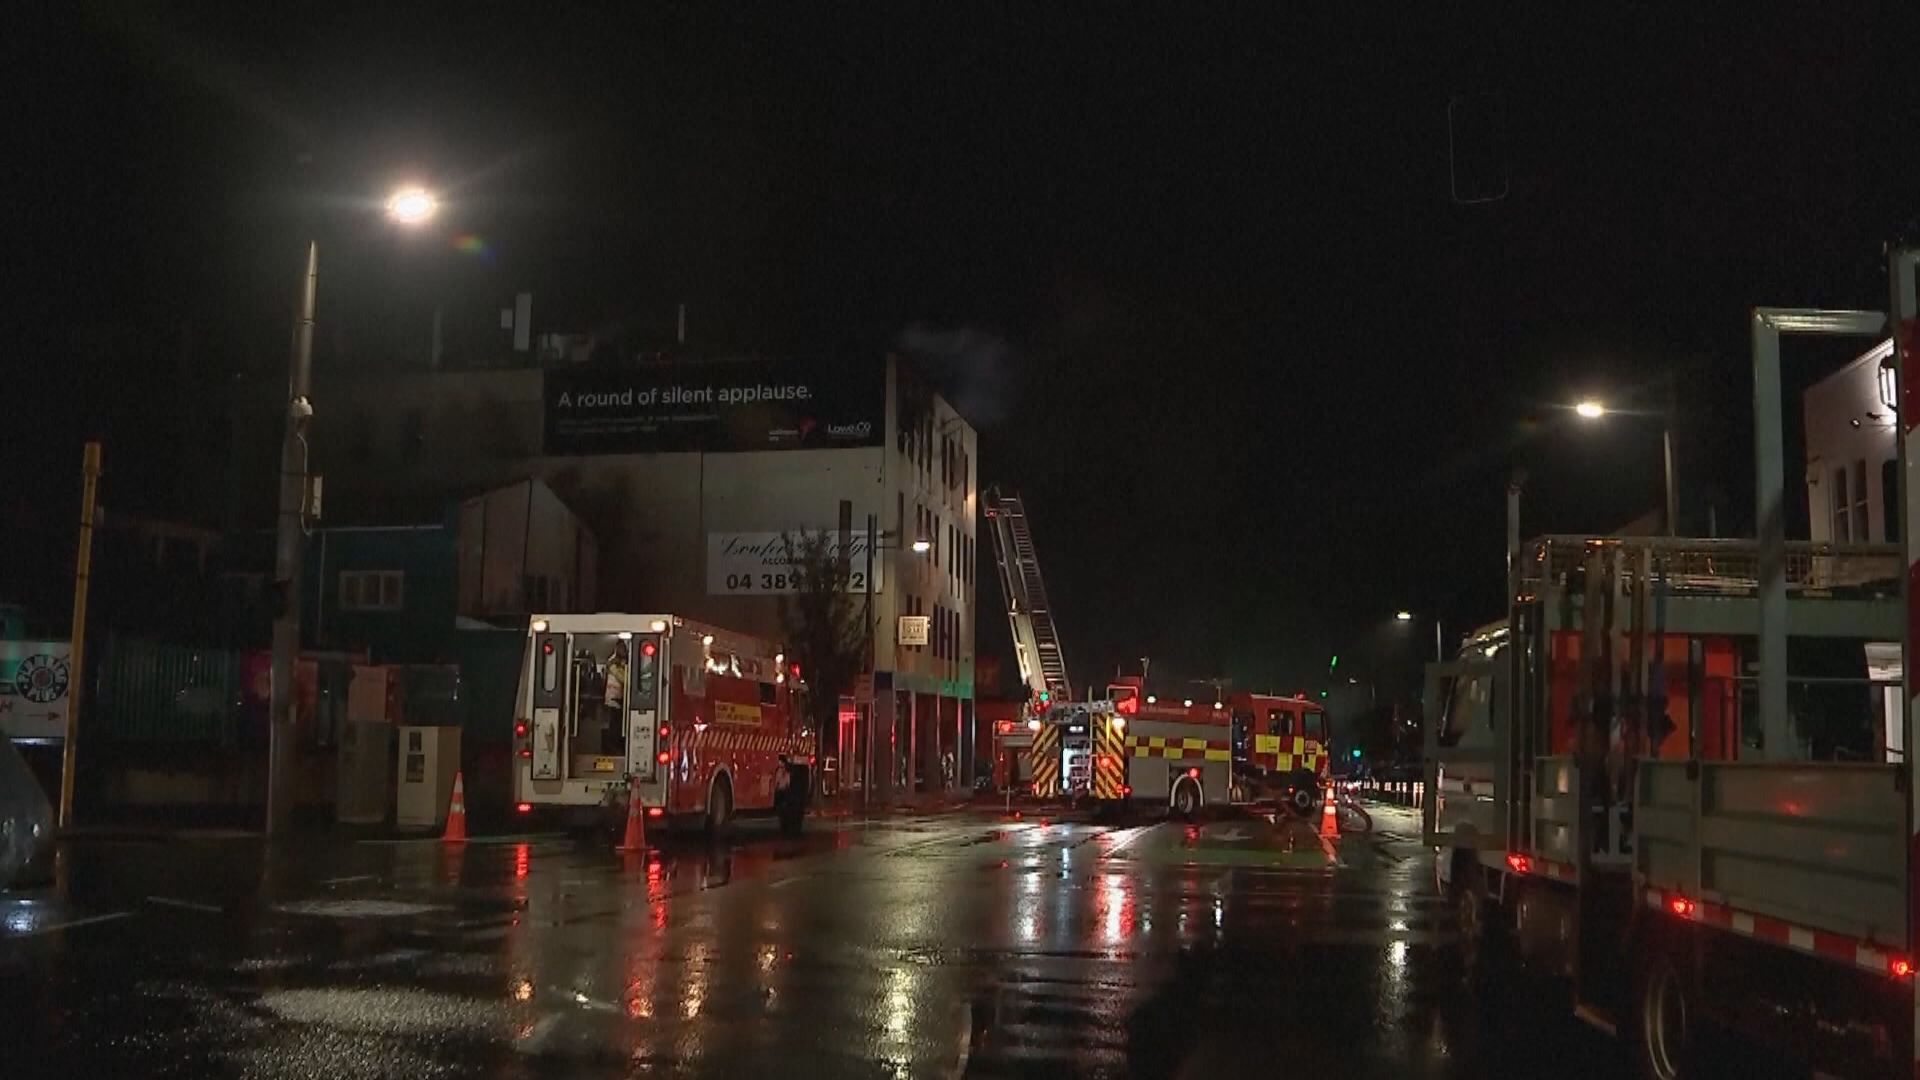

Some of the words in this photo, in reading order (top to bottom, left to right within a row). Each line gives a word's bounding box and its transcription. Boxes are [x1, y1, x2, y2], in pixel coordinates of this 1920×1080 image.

[557, 391, 573, 408] A
[577, 387, 633, 408] round
[637, 386, 658, 406] of
[661, 385, 713, 404] silent
[717, 382, 813, 405] applause.
[726, 573, 752, 589] 04
